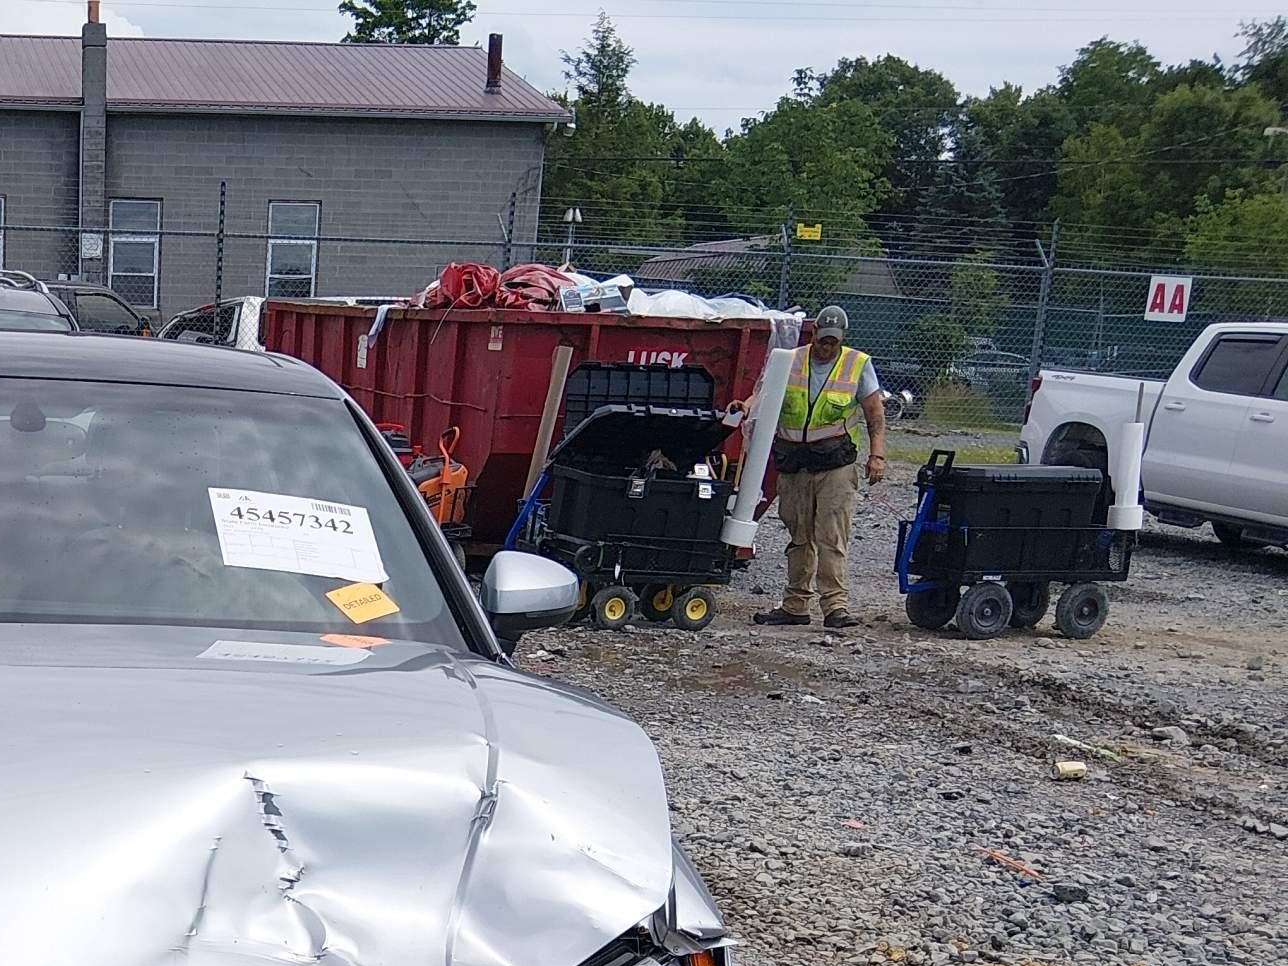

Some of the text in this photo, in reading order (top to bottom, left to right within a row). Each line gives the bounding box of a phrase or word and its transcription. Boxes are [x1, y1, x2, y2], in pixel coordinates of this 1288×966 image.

[1149, 283, 1184, 314] AA
[230, 506, 354, 535] 45457342
[343, 593, 382, 610] DETAILED
